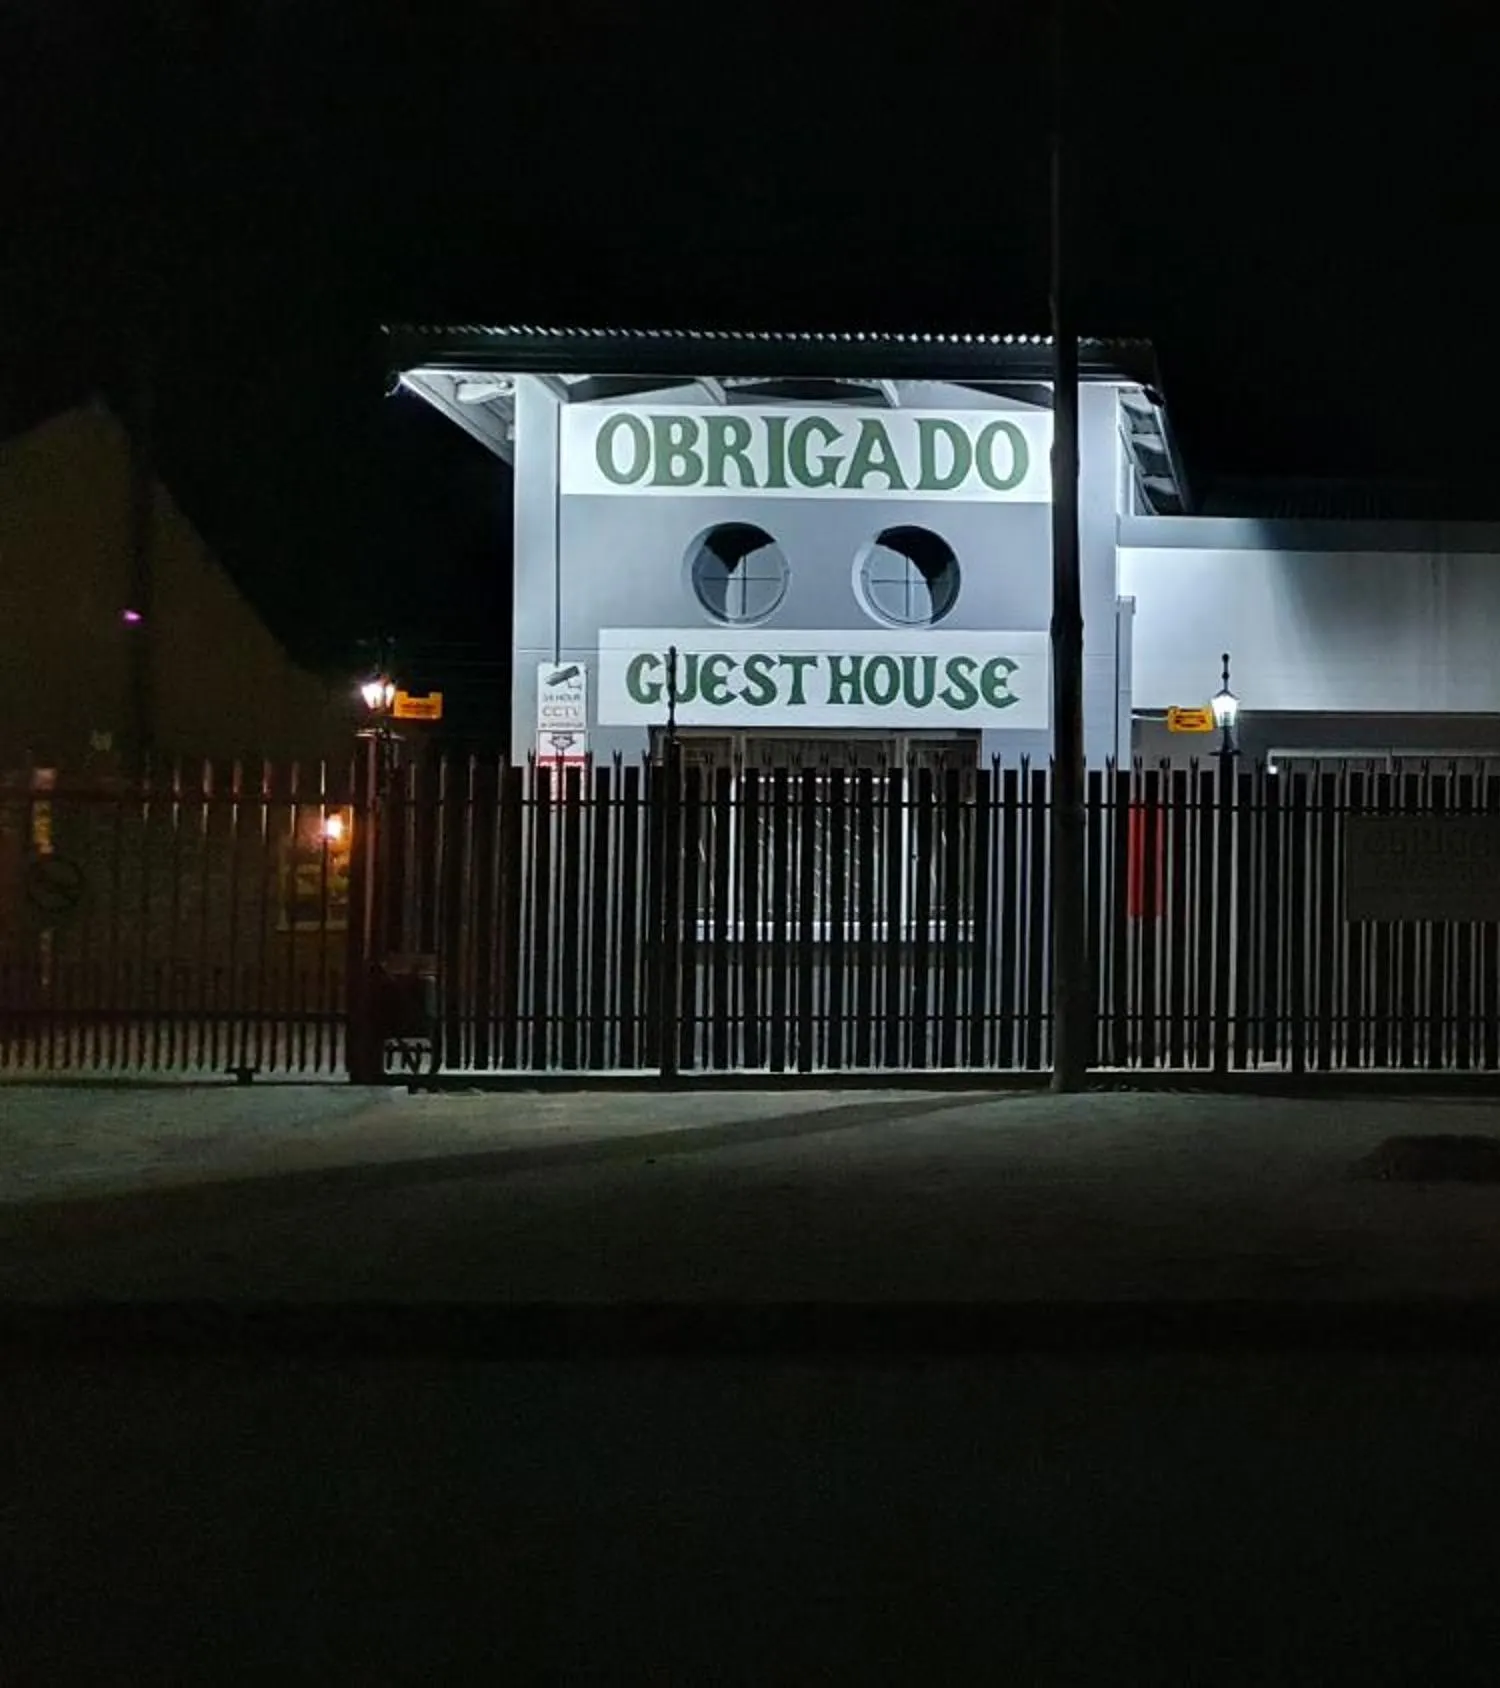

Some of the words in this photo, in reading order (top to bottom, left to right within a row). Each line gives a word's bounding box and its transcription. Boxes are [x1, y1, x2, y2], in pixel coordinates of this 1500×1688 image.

[595, 413, 1029, 491] OBRIGADO
[625, 653, 818, 707] GUEST
[825, 654, 1020, 710] HOUSE
